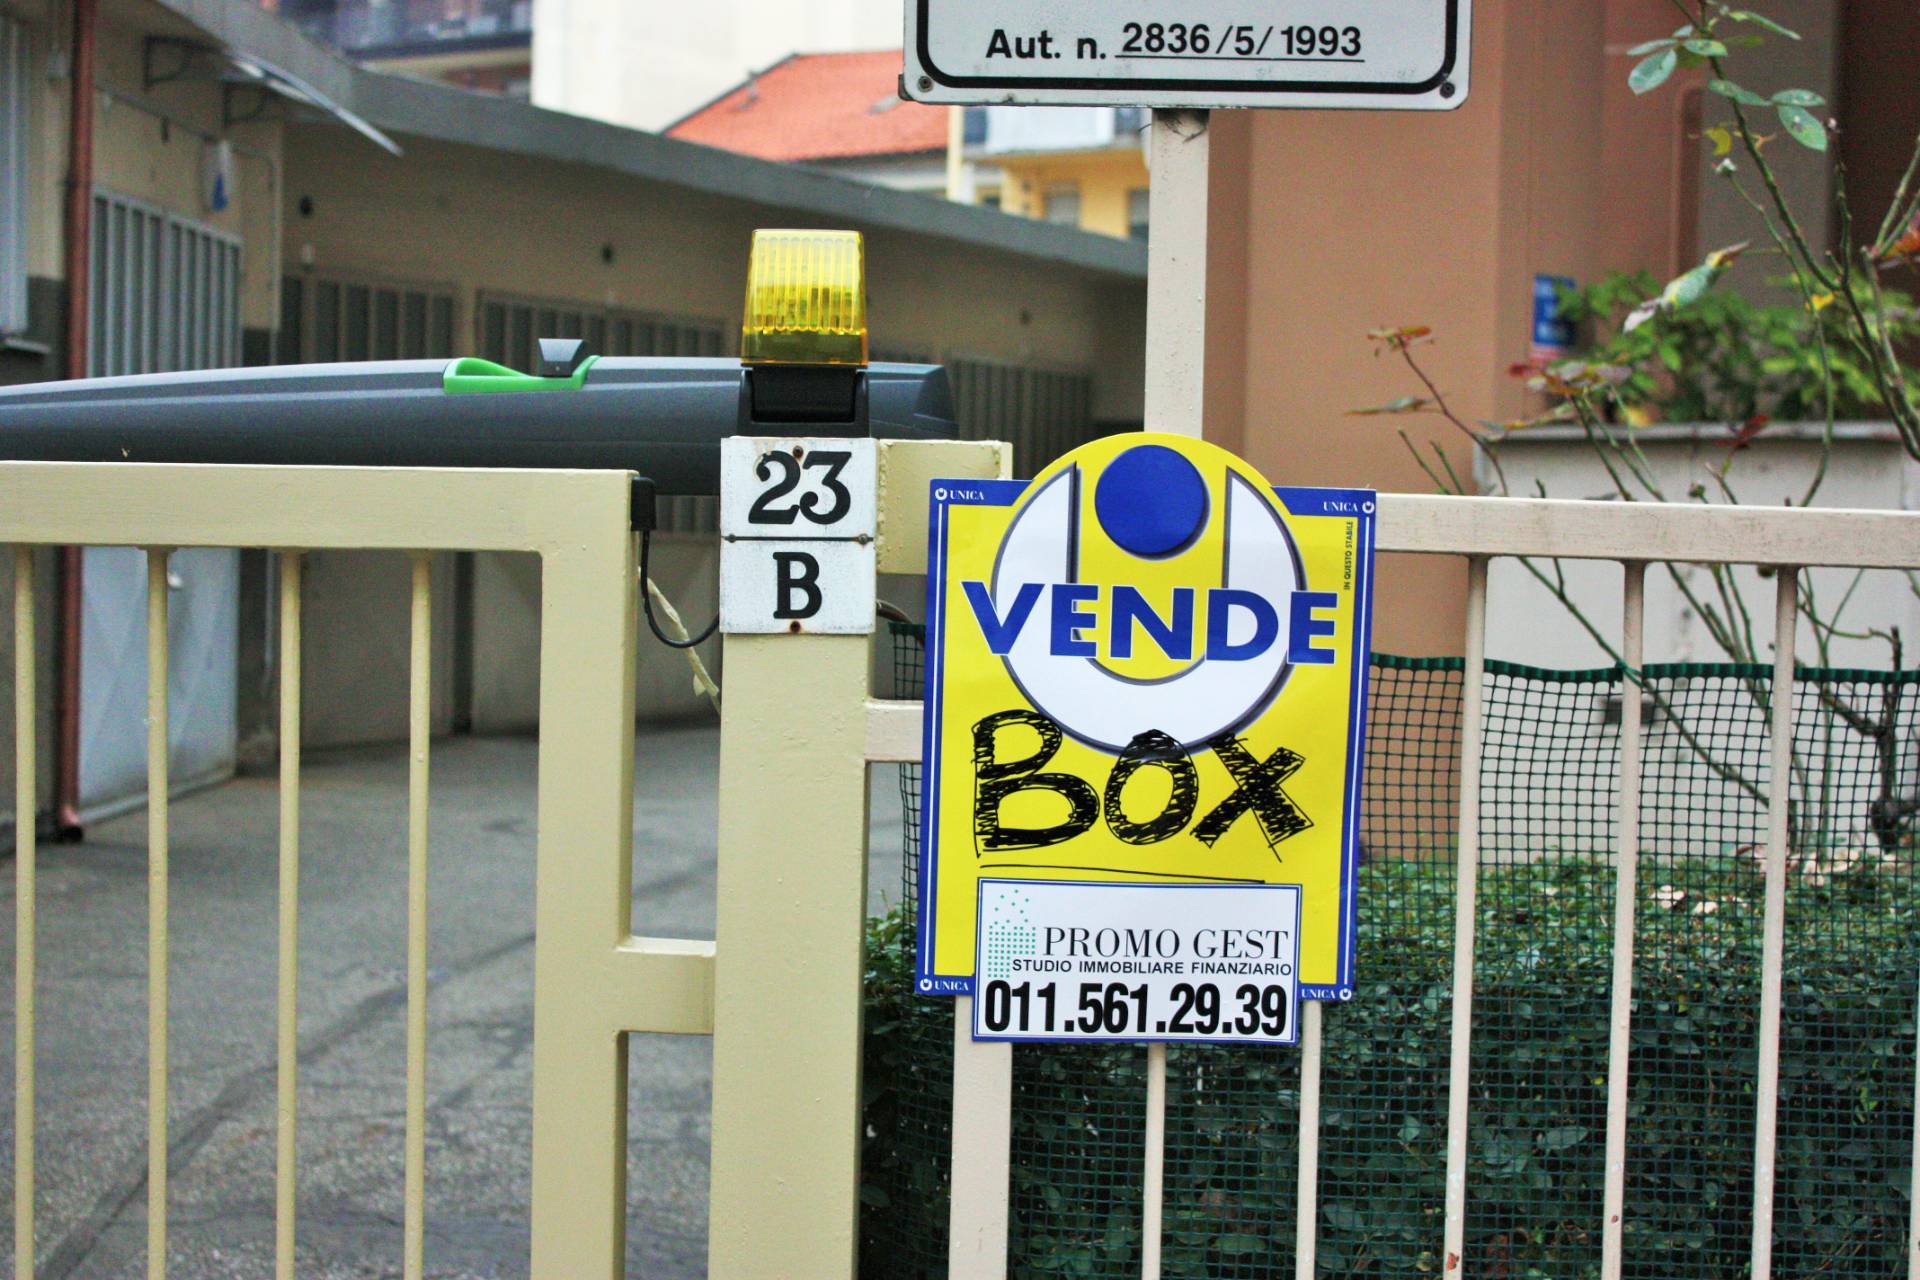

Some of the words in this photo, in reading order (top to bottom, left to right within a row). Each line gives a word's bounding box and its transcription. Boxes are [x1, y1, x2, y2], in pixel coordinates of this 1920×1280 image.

[985, 28, 1061, 59] Aut.
[1076, 37, 1107, 60] n.
[1121, 22, 1363, 57] 2836/5/1993
[748, 450, 852, 525] 23
[949, 489, 985, 501] UNICA
[1323, 501, 1359, 513] UNICA
[1345, 521, 1353, 548] STABILE
[1344, 550, 1352, 580] QUESTO
[772, 552, 823, 619] B
[1344, 582, 1350, 590] IN
[961, 580, 1338, 665] VENDE
[971, 709, 1314, 862] BOX
[1043, 926, 1181, 959] PROMO
[1193, 929, 1289, 960] GEST
[1012, 958, 1072, 973] STUDIO
[1079, 959, 1184, 975] IMMOBILIARE
[1191, 961, 1292, 976] FINANZIARIO
[934, 980, 969, 991] UNICA
[1301, 988, 1336, 999] UNICA
[984, 980, 1288, 1036] 011.561.29.39
